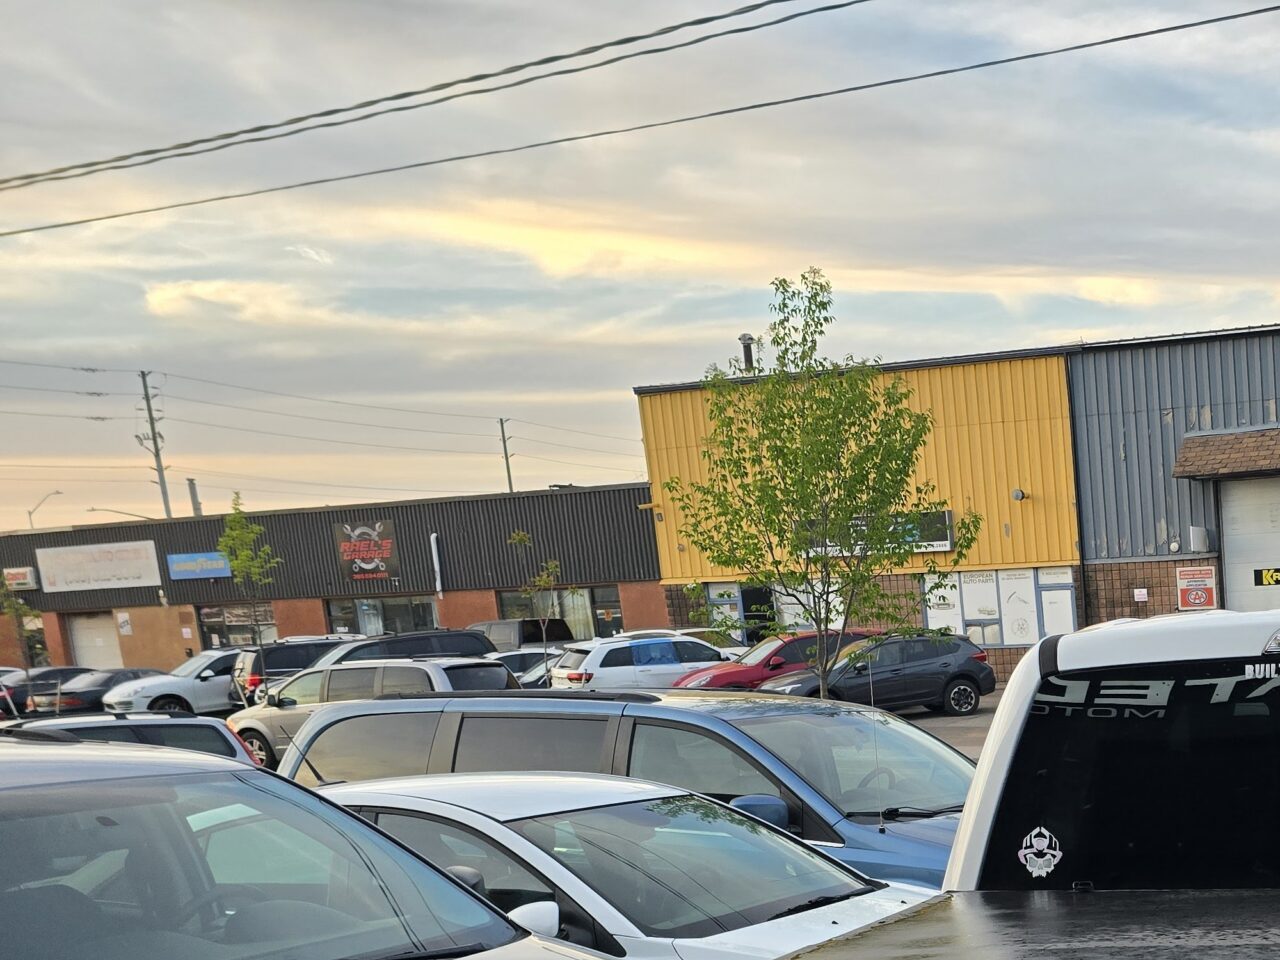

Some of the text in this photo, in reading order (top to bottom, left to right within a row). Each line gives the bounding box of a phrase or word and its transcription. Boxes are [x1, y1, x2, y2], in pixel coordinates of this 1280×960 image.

[340, 538, 393, 552] RAEL'S
[343, 550, 391, 560] GARAGE
[1189, 589, 1206, 601] CAA
